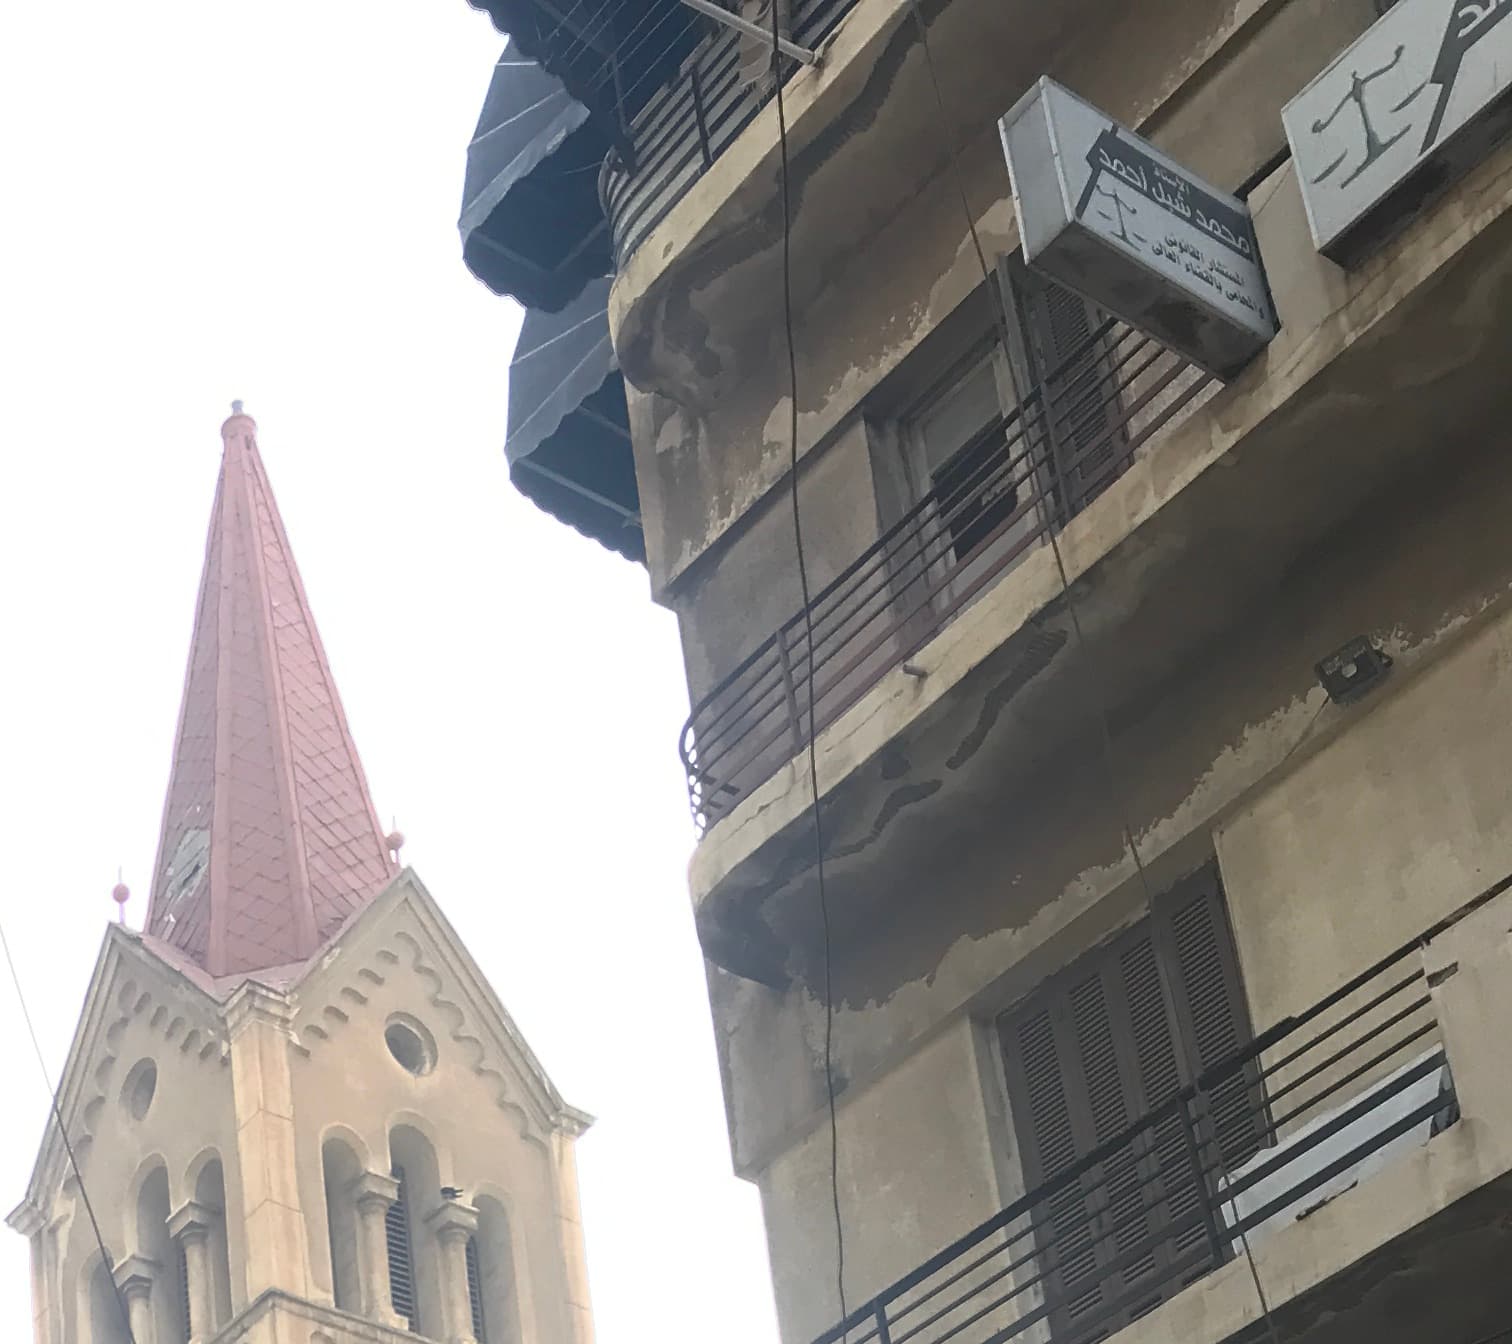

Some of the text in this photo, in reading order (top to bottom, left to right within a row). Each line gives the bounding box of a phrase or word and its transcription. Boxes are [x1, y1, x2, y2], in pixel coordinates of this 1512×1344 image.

[1196, 208, 1250, 253] محمد
[1185, 261, 1223, 294] بالقضاء
[1208, 258, 1245, 287] المستشار
